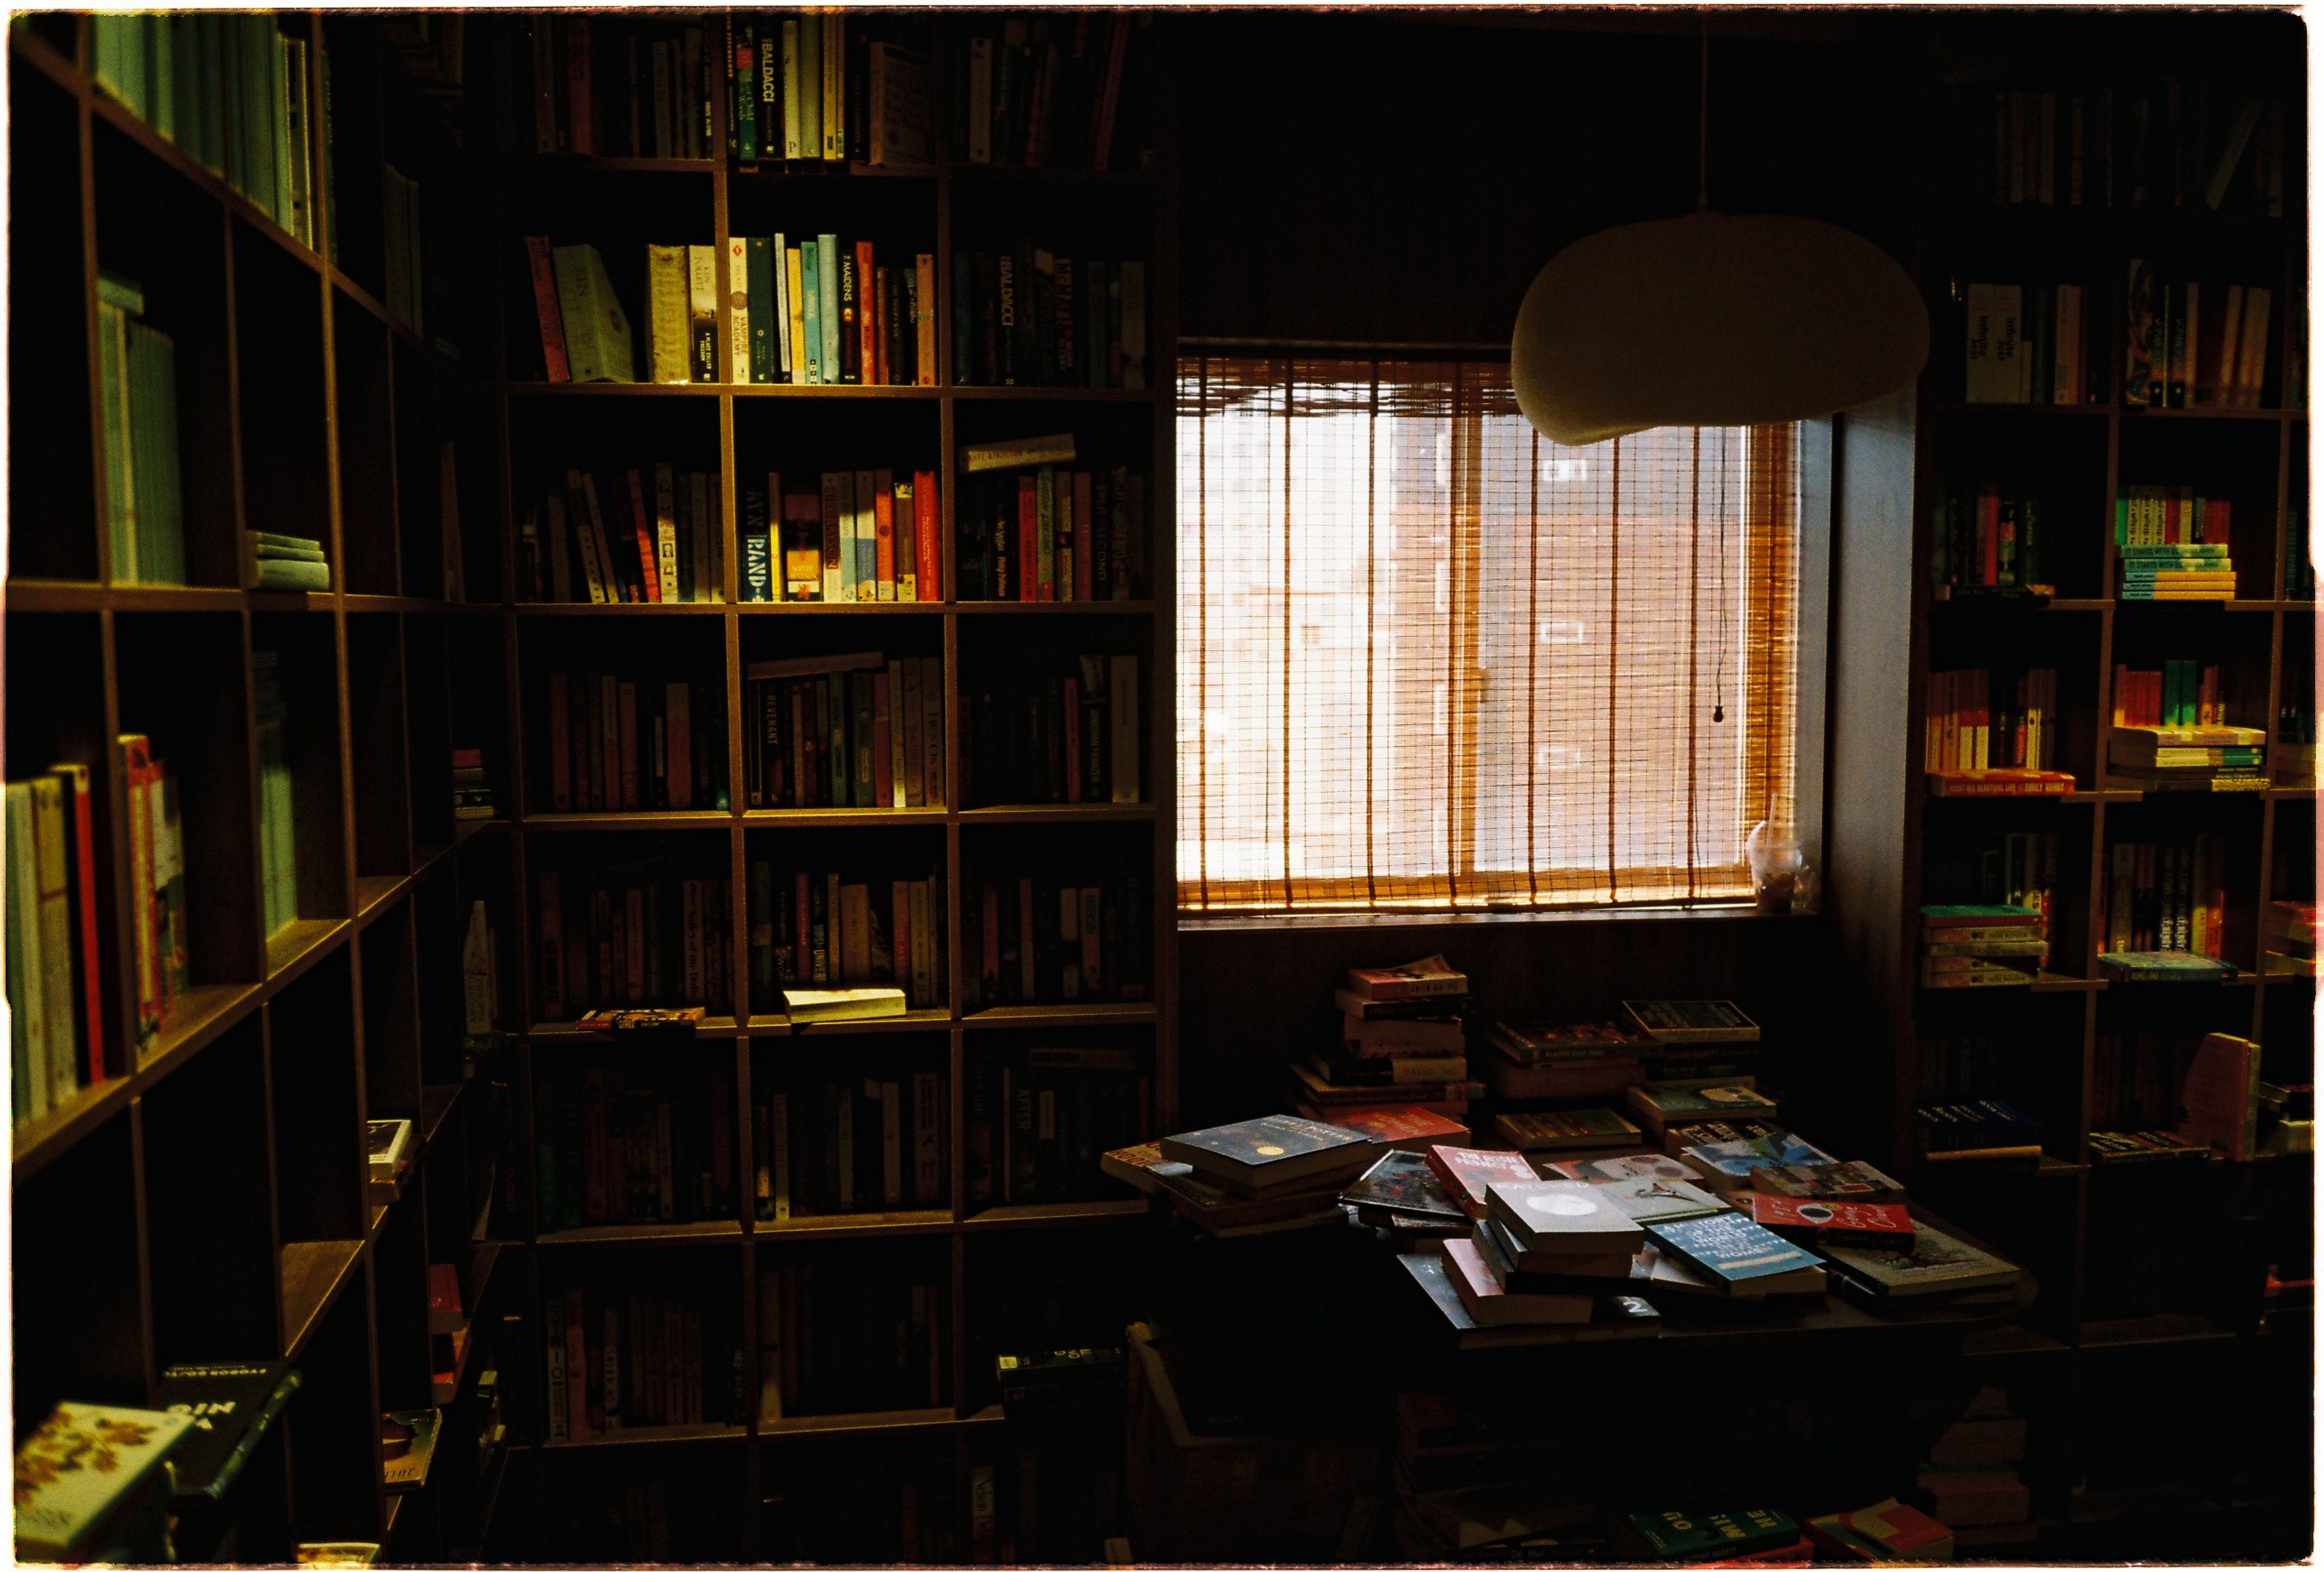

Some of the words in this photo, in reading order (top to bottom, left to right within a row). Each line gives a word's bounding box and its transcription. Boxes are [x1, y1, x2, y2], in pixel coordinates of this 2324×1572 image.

[761, 42, 775, 102] BALDACCI
[842, 261, 852, 301] MAIDENS
[1000, 260, 1014, 327] BALDACCI
[1970, 338, 1978, 361] Jest
[1978, 315, 1989, 357] Infinite
[1997, 338, 2005, 362] Jest
[2006, 317, 2016, 358] Infinite
[2175, 318, 2184, 347] WOMAN
[746, 491, 764, 526] AYN
[826, 488, 835, 513] BILL
[827, 518, 838, 568] BRYSON
[1096, 525, 1107, 581] SECOND
[747, 539, 767, 588] RAND
[766, 694, 778, 745] REVENANT
[1089, 709, 1100, 746] JONATHAN
[1089, 748, 1101, 782] FRANZEN
[686, 911, 698, 939] Valley
[778, 911, 787, 941] Slaughter
[689, 942, 698, 951] of
[689, 954, 700, 969] the
[689, 973, 699, 999] Dolls
[1016, 1089, 1032, 1131] AFTER
